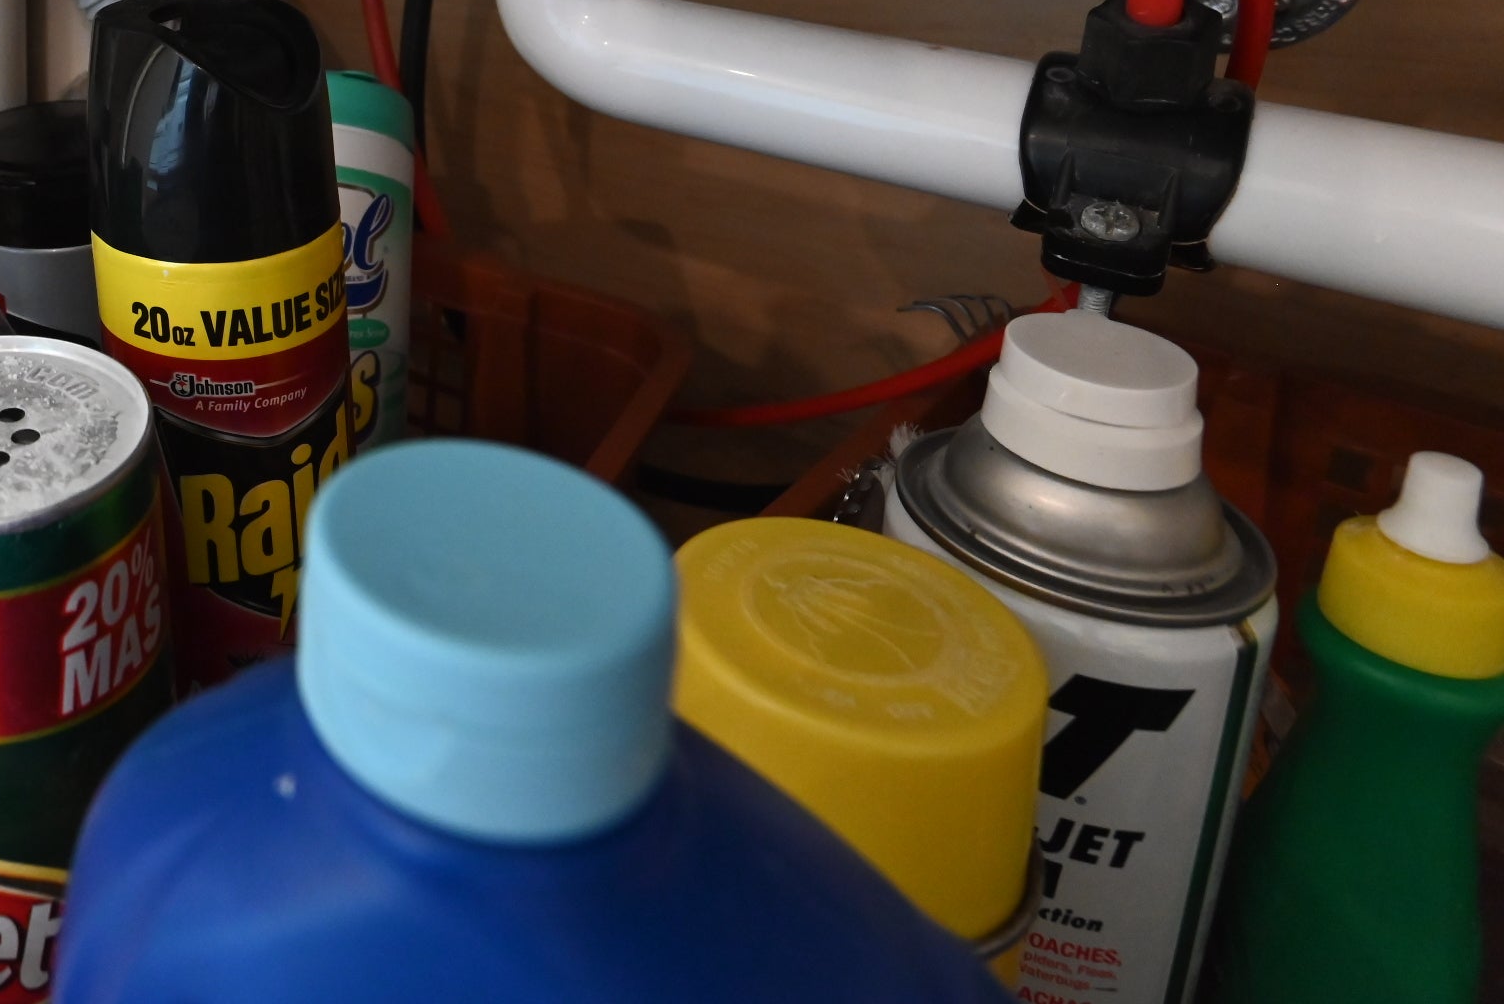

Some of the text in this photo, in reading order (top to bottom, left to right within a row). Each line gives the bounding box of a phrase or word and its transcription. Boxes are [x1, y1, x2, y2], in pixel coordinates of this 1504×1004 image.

[200, 292, 312, 348] VALUE
[315, 263, 345, 322] SIZ
[170, 373, 254, 397] SC Johnson
[195, 386, 308, 412] A Family Company
[63, 524, 154, 653] 20%
[61, 583, 161, 716] MAS
